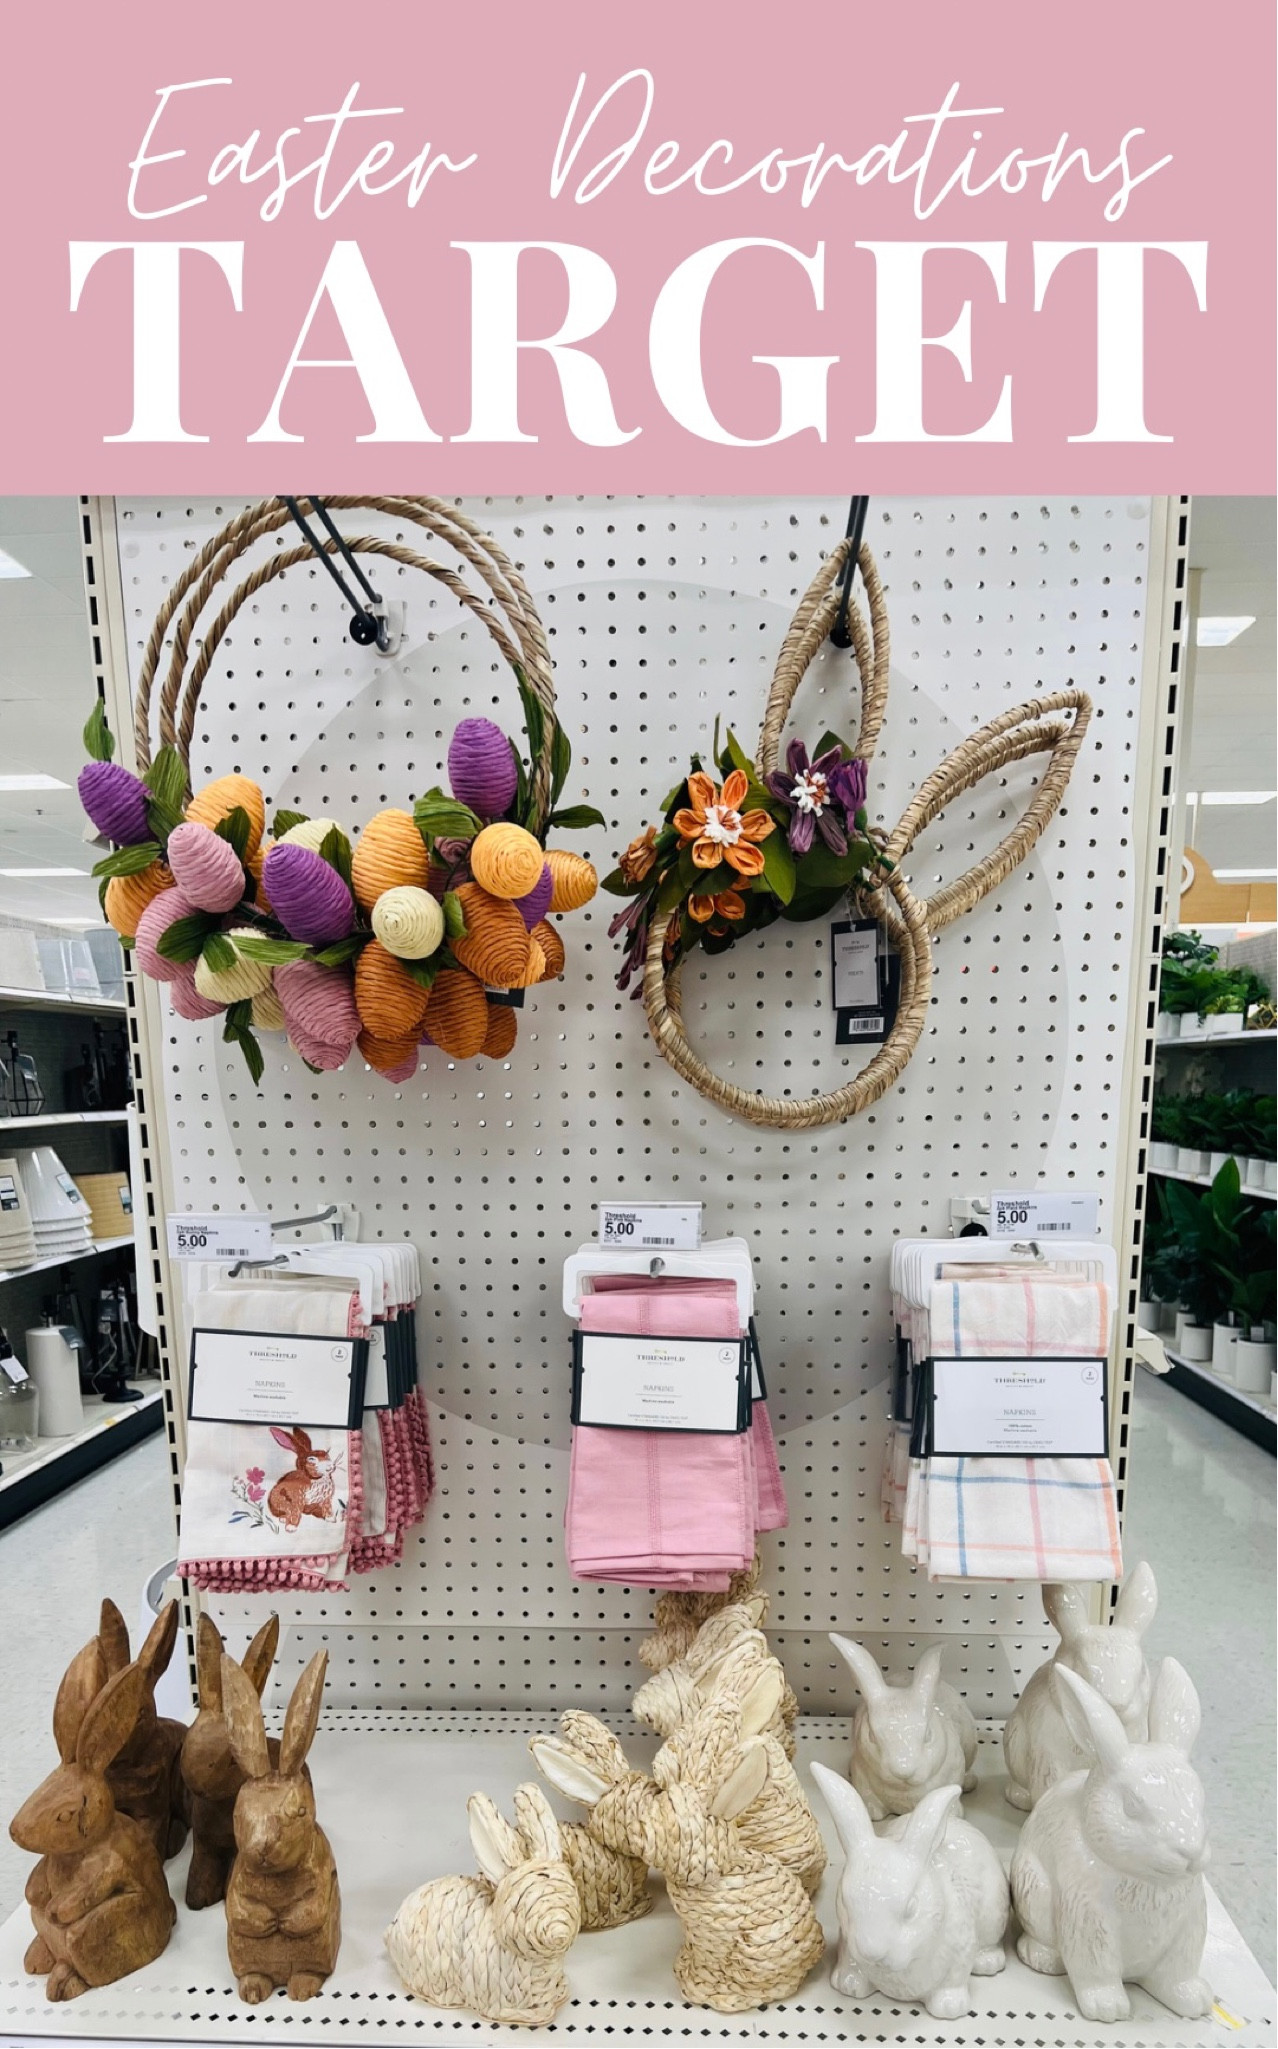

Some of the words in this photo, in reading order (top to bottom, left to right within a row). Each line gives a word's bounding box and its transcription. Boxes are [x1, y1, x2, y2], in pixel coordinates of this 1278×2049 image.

[997, 1210, 1028, 1224] 5.00
[605, 1222, 635, 1235] 5.00
[178, 1234, 207, 1247] 5.00
[249, 1350, 297, 1359] THRESHOLD
[637, 1354, 685, 1362] THRESHOLD
[255, 1380, 285, 1388] NAPKINS
[643, 1384, 674, 1392] NAPKINS
